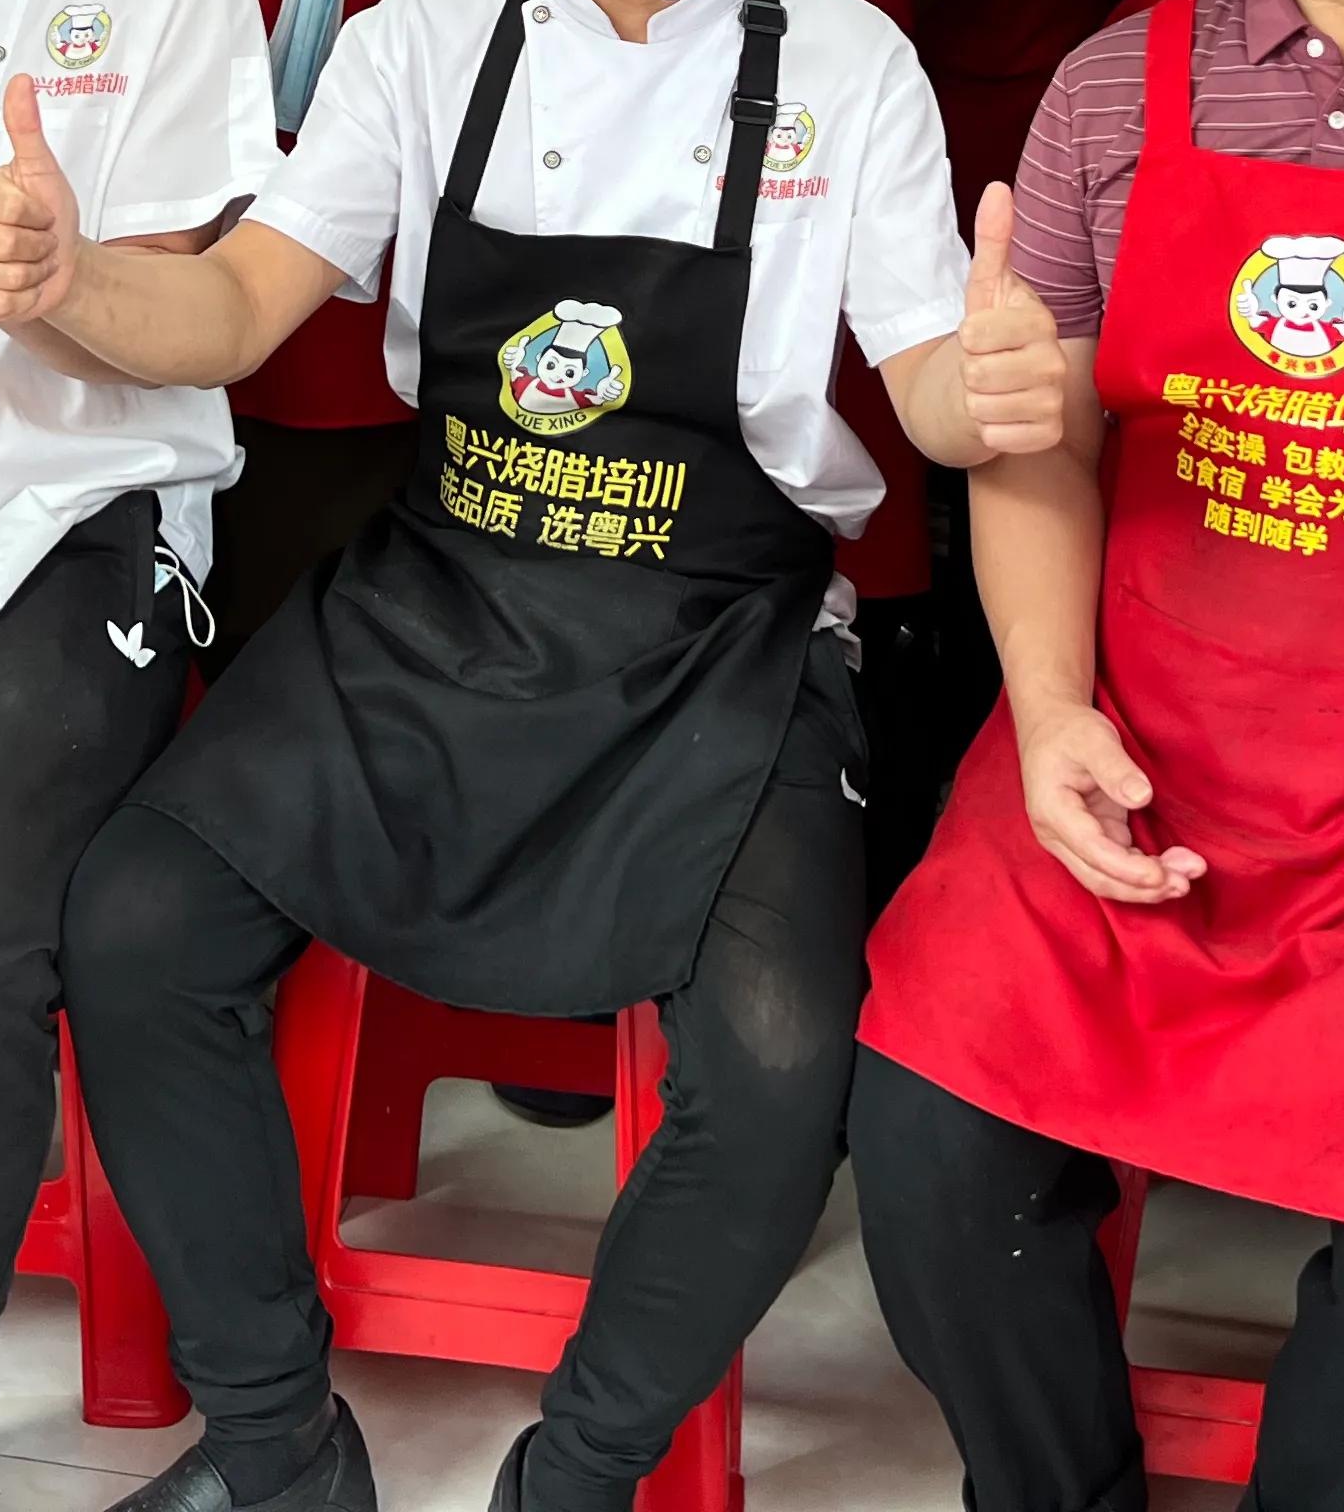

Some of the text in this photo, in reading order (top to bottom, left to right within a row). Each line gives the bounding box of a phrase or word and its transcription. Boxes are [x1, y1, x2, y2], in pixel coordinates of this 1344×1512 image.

[513, 409, 588, 431] YUE XING
[444, 413, 687, 512] 粤兴烧腊培训
[1175, 448, 1247, 502] 包食宿
[439, 461, 674, 561] 选品质 选粤兴
[1203, 497, 1329, 557] 随到随学
